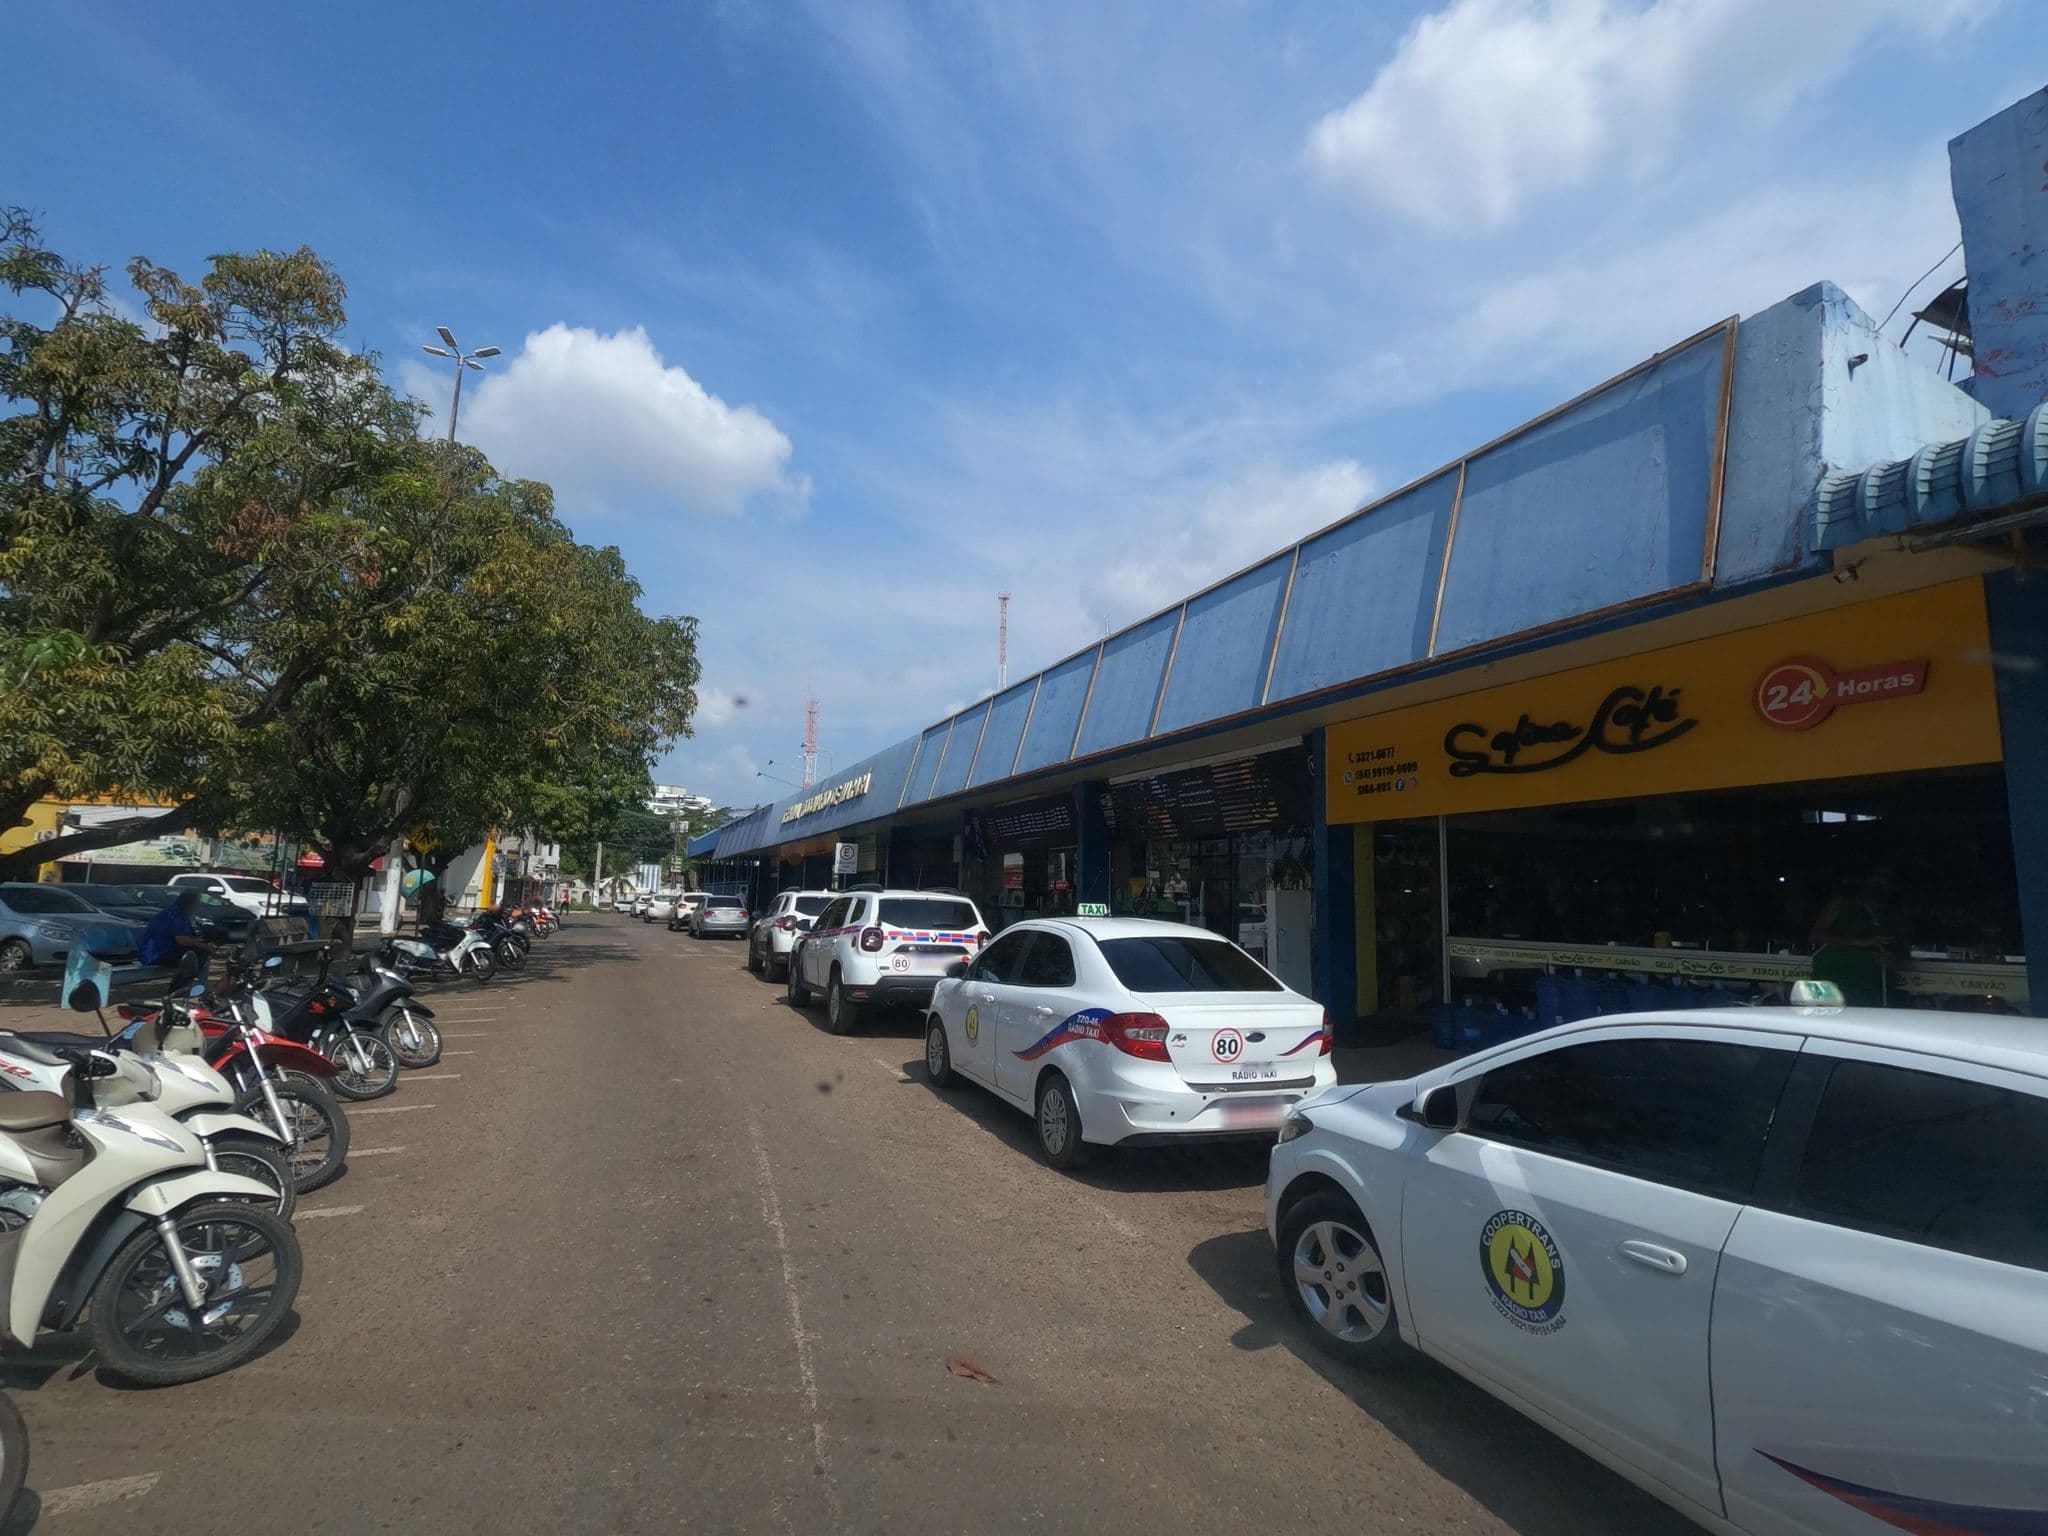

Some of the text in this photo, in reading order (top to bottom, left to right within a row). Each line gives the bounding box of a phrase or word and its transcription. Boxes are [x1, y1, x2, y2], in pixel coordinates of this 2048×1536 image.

[1767, 673, 1914, 711] 24 Horas
[1081, 904, 1105, 914] TAXI
[895, 959, 908, 968] 80
[1752, 967, 1779, 976] XEROX
[1086, 1026, 1100, 1038] TAXI
[1216, 1039, 1238, 1055] 80
[1482, 1211, 1561, 1270] COOPERTRANS
[1528, 1309, 1547, 1321] TAXI
